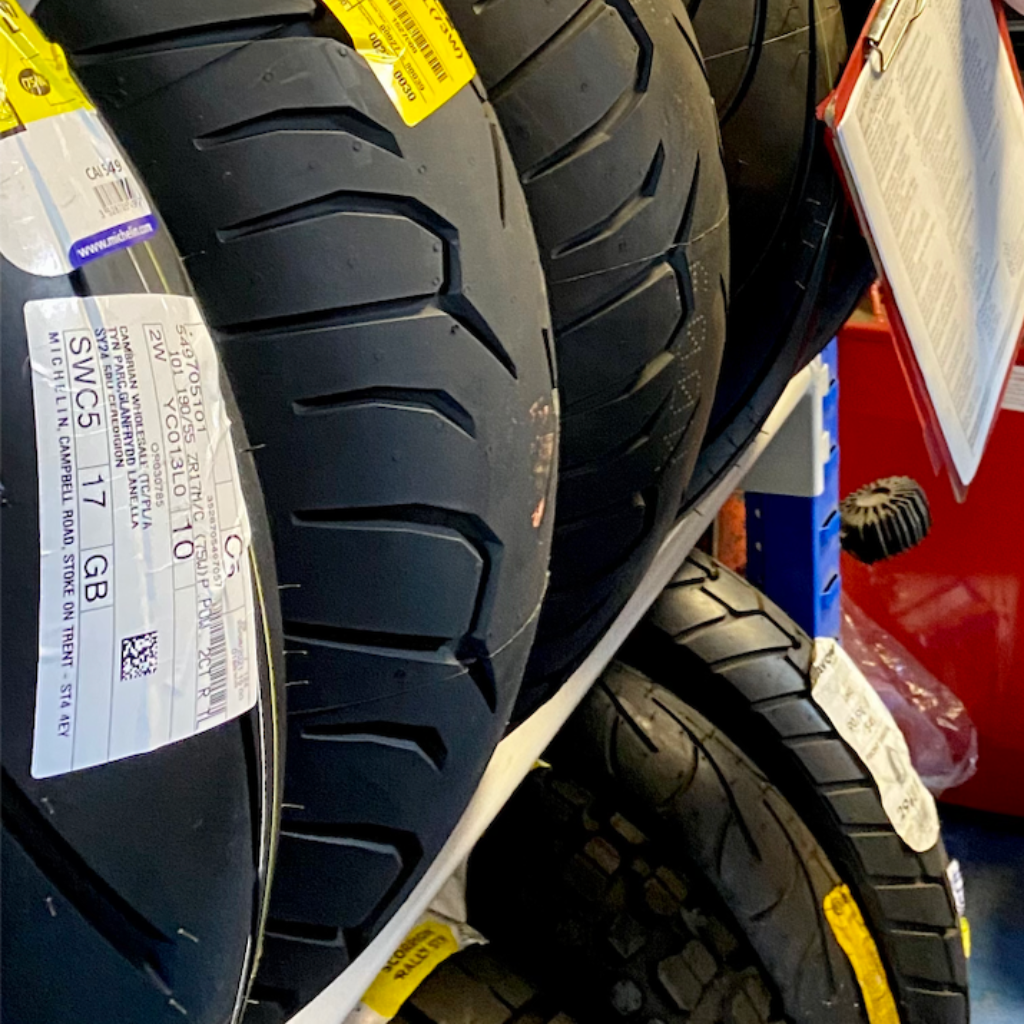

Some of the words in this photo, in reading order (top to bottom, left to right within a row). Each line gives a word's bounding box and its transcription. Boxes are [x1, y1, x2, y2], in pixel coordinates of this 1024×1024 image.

[394, 70, 417, 102] 0030
[94, 327, 110, 360] SY24
[107, 326, 120, 350] TYN
[68, 335, 100, 430] SWC5
[118, 325, 138, 389] CAMBRIAN
[132, 394, 148, 468] WHOLESALE
[168, 350, 182, 375] 101
[175, 388, 195, 443] 190/55
[175, 324, 205, 433] 549705101
[148, 328, 166, 362] 2W
[170, 520, 195, 560] 10
[57, 436, 73, 505] CAMPBELL
[80, 473, 105, 510] 17
[62, 554, 74, 597] STOKE
[83, 554, 107, 603] GB
[62, 602, 73, 620] ON
[61, 625, 73, 668] TRENT
[60, 684, 71, 708] ST4
[57, 714, 70, 737] 4EY
[394, 948, 428, 980] RALLY
